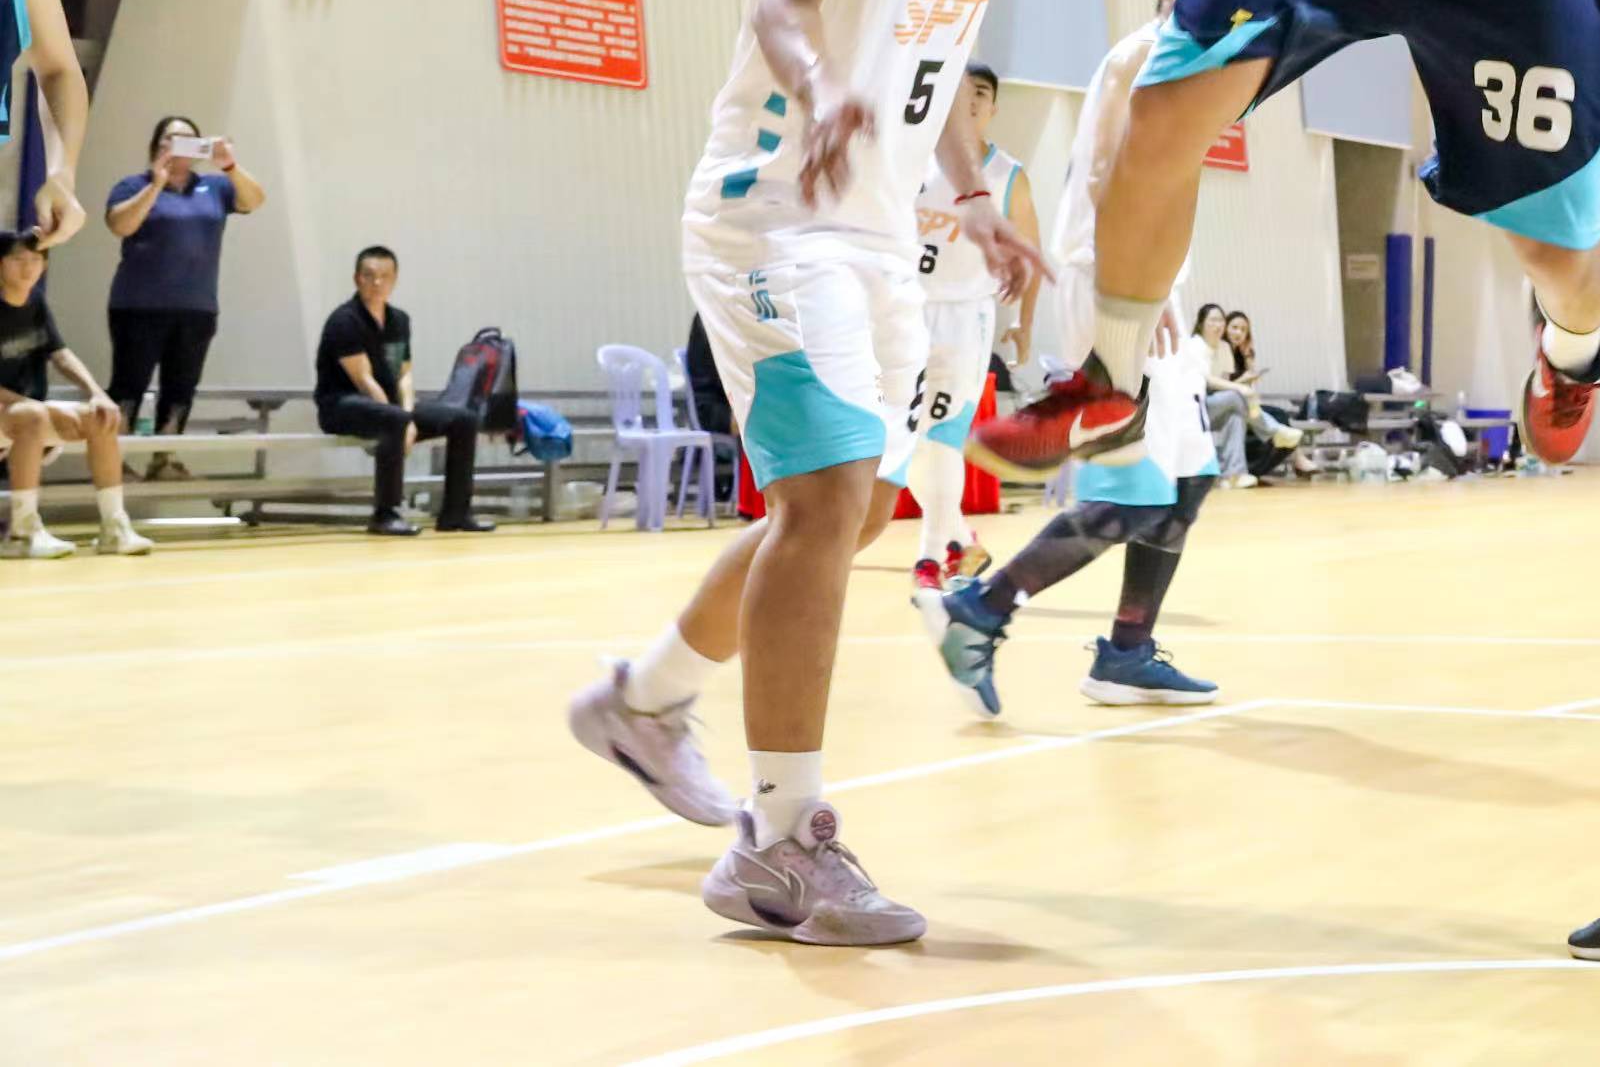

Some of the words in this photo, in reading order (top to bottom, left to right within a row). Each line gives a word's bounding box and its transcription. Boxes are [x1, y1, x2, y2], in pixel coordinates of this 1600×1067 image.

[904, 60, 945, 125] 5
[1474, 59, 1576, 153] 36
[919, 244, 939, 274] 6
[930, 391, 952, 421] 6
